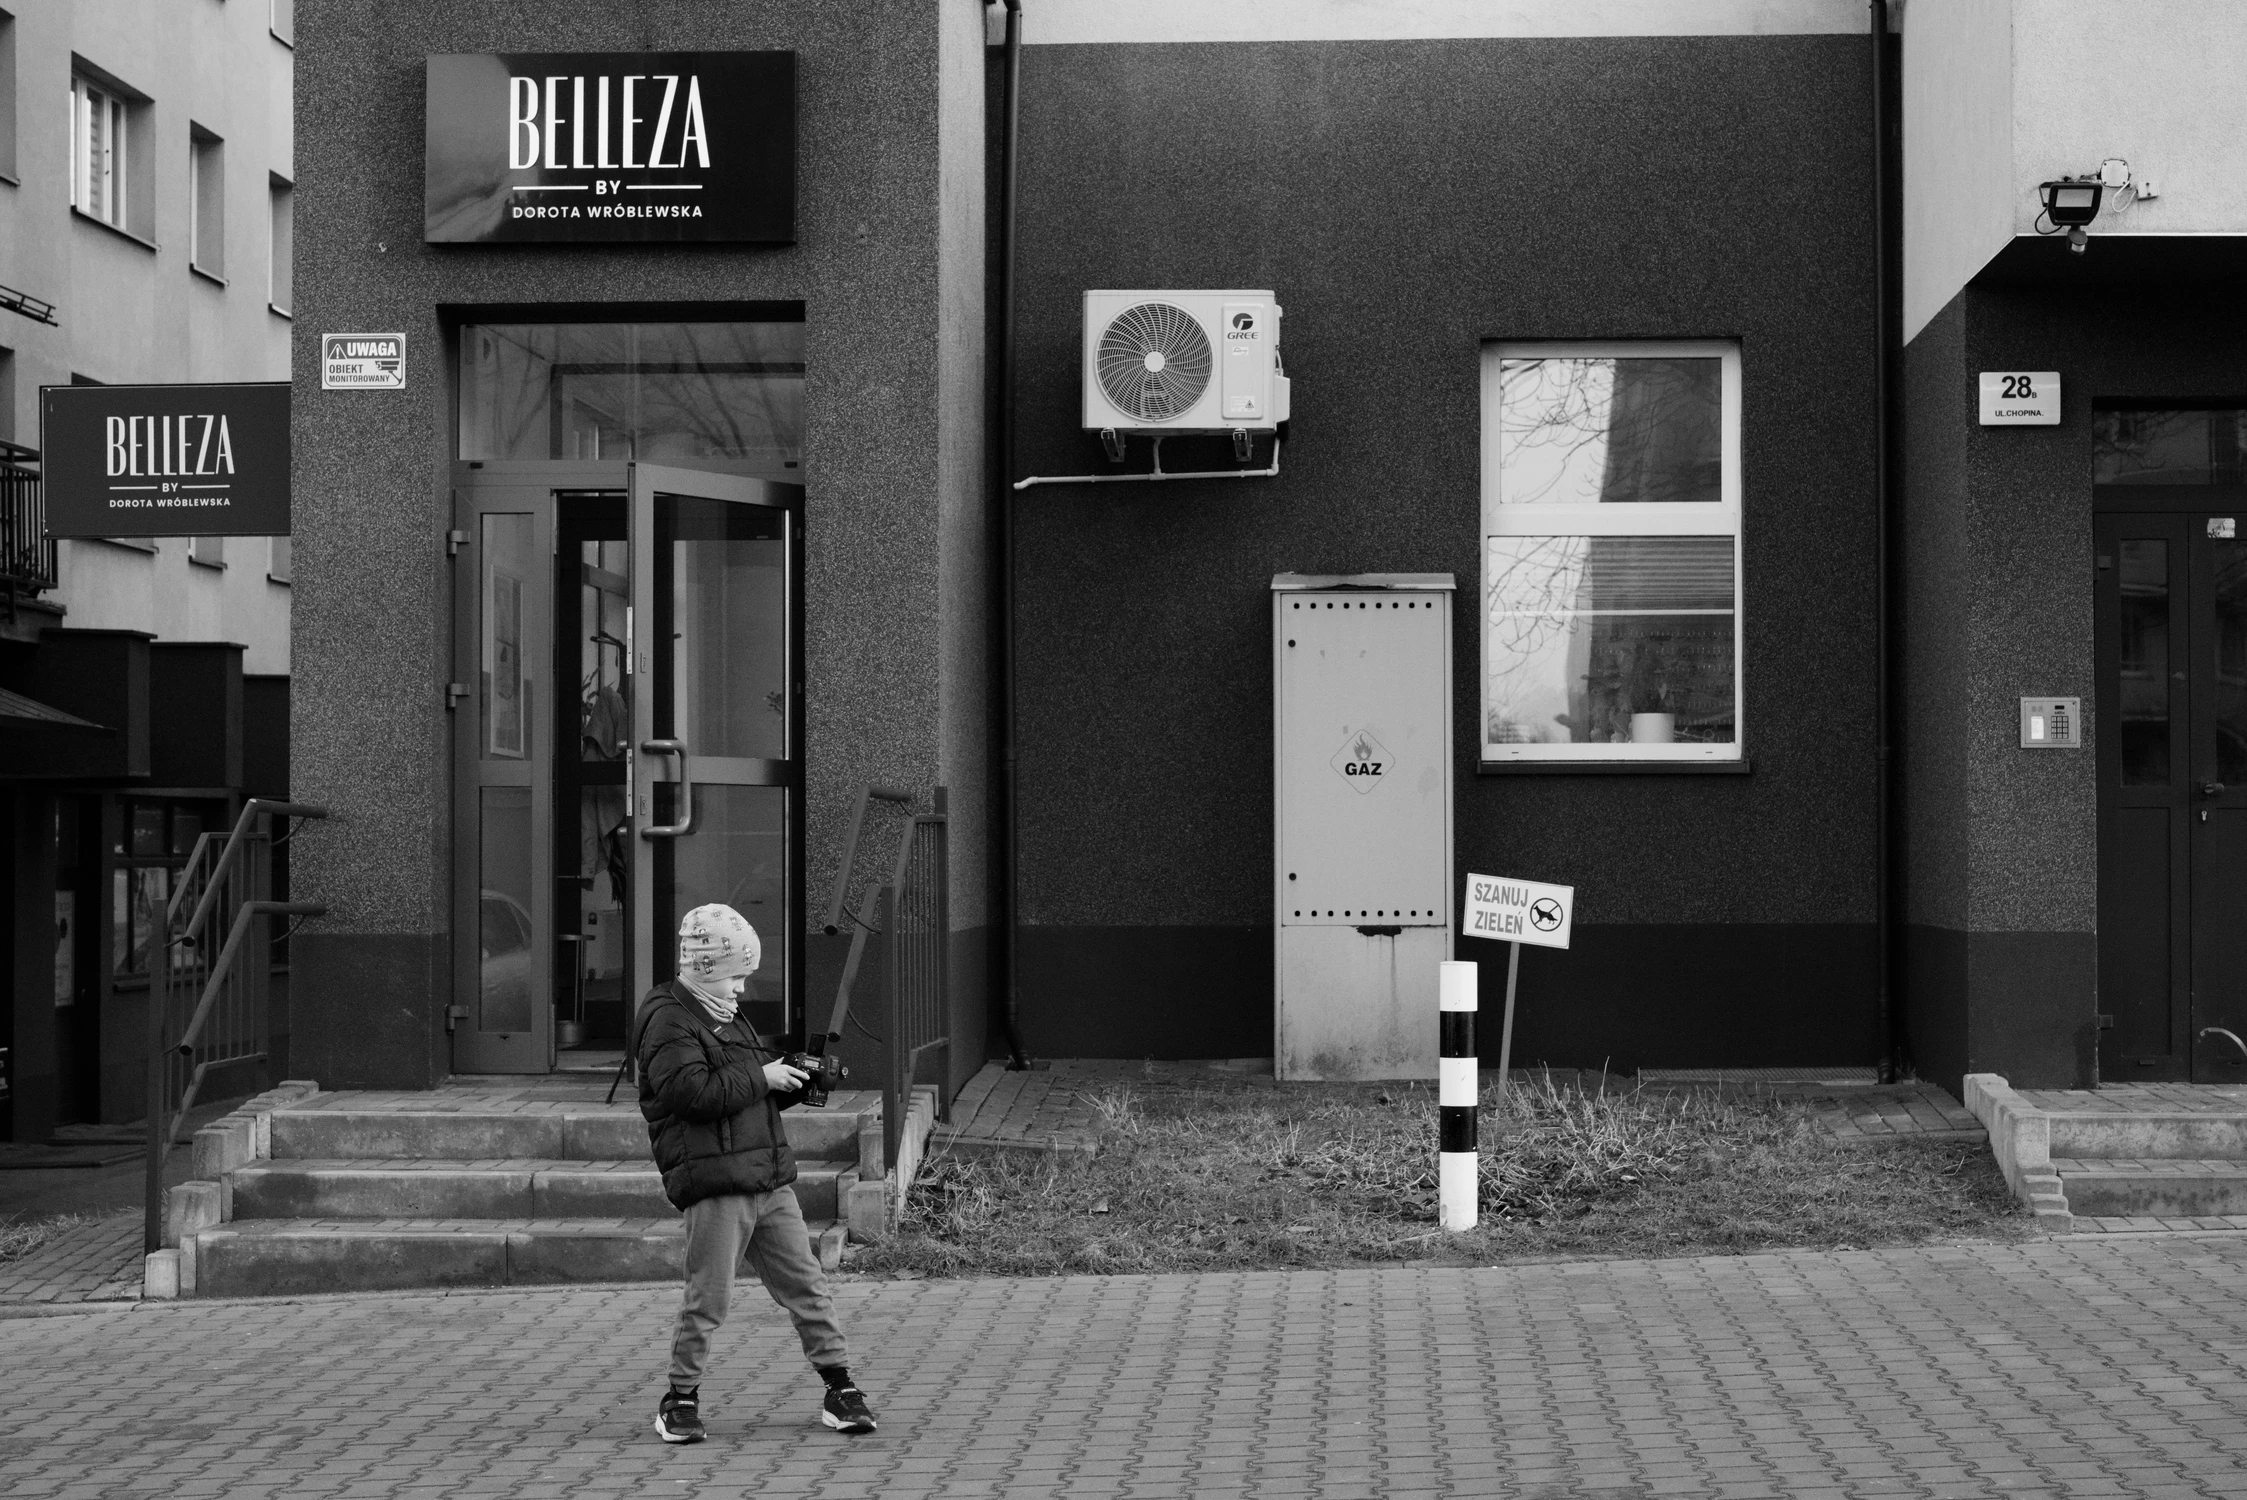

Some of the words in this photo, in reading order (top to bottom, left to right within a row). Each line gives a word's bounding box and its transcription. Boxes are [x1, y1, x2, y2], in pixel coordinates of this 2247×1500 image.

[509, 75, 710, 169] BELLEZA
[595, 180, 621, 195] BY
[512, 206, 581, 219] DOROTA
[587, 202, 703, 218] WRÓBLEWSKA
[1227, 331, 1259, 340] GREE
[346, 342, 397, 356] UWAGA
[328, 364, 363, 374] OBIEKT
[328, 375, 390, 383] MONITOROWANY
[106, 414, 235, 476] BELLEZA
[162, 482, 179, 493] BY
[109, 499, 153, 508] DOROTA
[156, 496, 231, 508] WRÓBLEWSKA
[1344, 762, 1382, 776] GAZ
[1474, 882, 1529, 908] SZANUJ
[1474, 911, 1524, 935] ZIELEŃ
